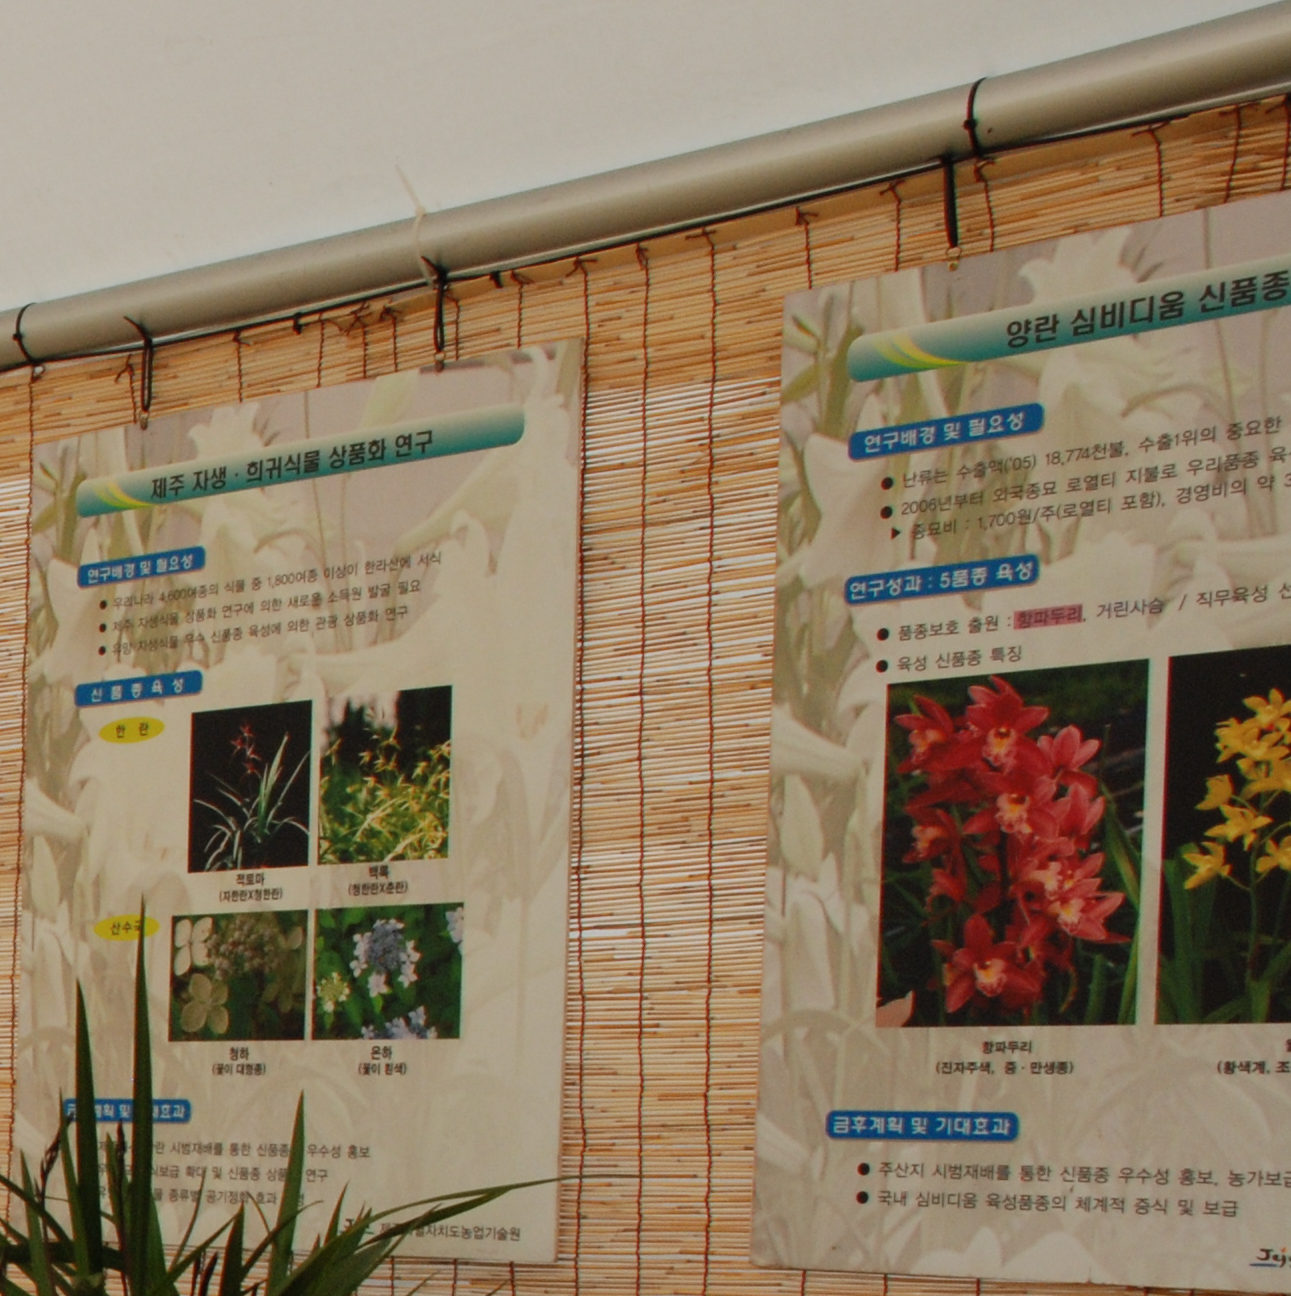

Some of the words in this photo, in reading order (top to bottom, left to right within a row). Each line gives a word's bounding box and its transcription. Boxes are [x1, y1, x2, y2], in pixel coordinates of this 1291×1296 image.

[1006, 314, 1060, 349] 양란
[1071, 291, 1186, 337] 심비디움
[1199, 269, 1291, 314] 신품종
[864, 426, 936, 453] 연구배경
[944, 421, 960, 441] 및
[969, 411, 1025, 437] 필요성
[151, 474, 185, 499] 제주
[192, 466, 227, 493] 자생
[246, 449, 321, 483] 희귀식물
[328, 438, 387, 469] 상품화
[395, 430, 433, 459] 연구
[903, 468, 948, 488] 난류는
[1138, 426, 1217, 451] 수출1위의
[1226, 416, 1281, 441] 중요한
[901, 492, 984, 515] 2006년부터
[993, 480, 1057, 503] 외국종묘
[1067, 472, 1116, 494] 로열티
[1126, 464, 1177, 484] 지불로
[1187, 450, 1259, 474] 우리품종
[912, 521, 957, 540] 종묘비
[1177, 478, 1247, 504] 경영비의
[87, 564, 135, 585] 연구배경
[323, 561, 358, 580] 이상이
[365, 556, 412, 576] 한라산에
[417, 551, 442, 567] 서식
[850, 575, 922, 600] 연구성과
[940, 567, 988, 589] 5품종
[997, 561, 1034, 581] 육성
[185, 606, 217, 623] 상품화
[221, 601, 255, 618] 연구에
[398, 579, 421, 596] 필요
[343, 609, 379, 627] 상품화
[384, 605, 408, 622] 연구
[899, 620, 959, 641] 품종보호
[968, 615, 999, 634] 출원
[1097, 597, 1164, 620] 거린사슴
[1196, 585, 1268, 609] 직무육성
[897, 655, 927, 673] 육성
[936, 650, 982, 669] 신품종
[989, 645, 1022, 662] 특징
[833, 1115, 904, 1134] 금후계획
[911, 1116, 928, 1135] 및
[935, 1117, 1011, 1136] 기대효과
[307, 1144, 341, 1159] 우수성
[878, 1162, 925, 1179] 주산지
[932, 1164, 1011, 1181] 시범재배를
[1019, 1165, 1051, 1182] 통한
[1060, 1166, 1109, 1184] 신품종
[1118, 1168, 1170, 1186] 우수성
[878, 1191, 907, 1207] 국내
[917, 1192, 977, 1209] 심비디움
[986, 1193, 1066, 1211] 육성품종의
[1075, 1197, 1125, 1213] 체계적
[1177, 1199, 1194, 1216] 및
[1203, 1200, 1239, 1217] 보급
